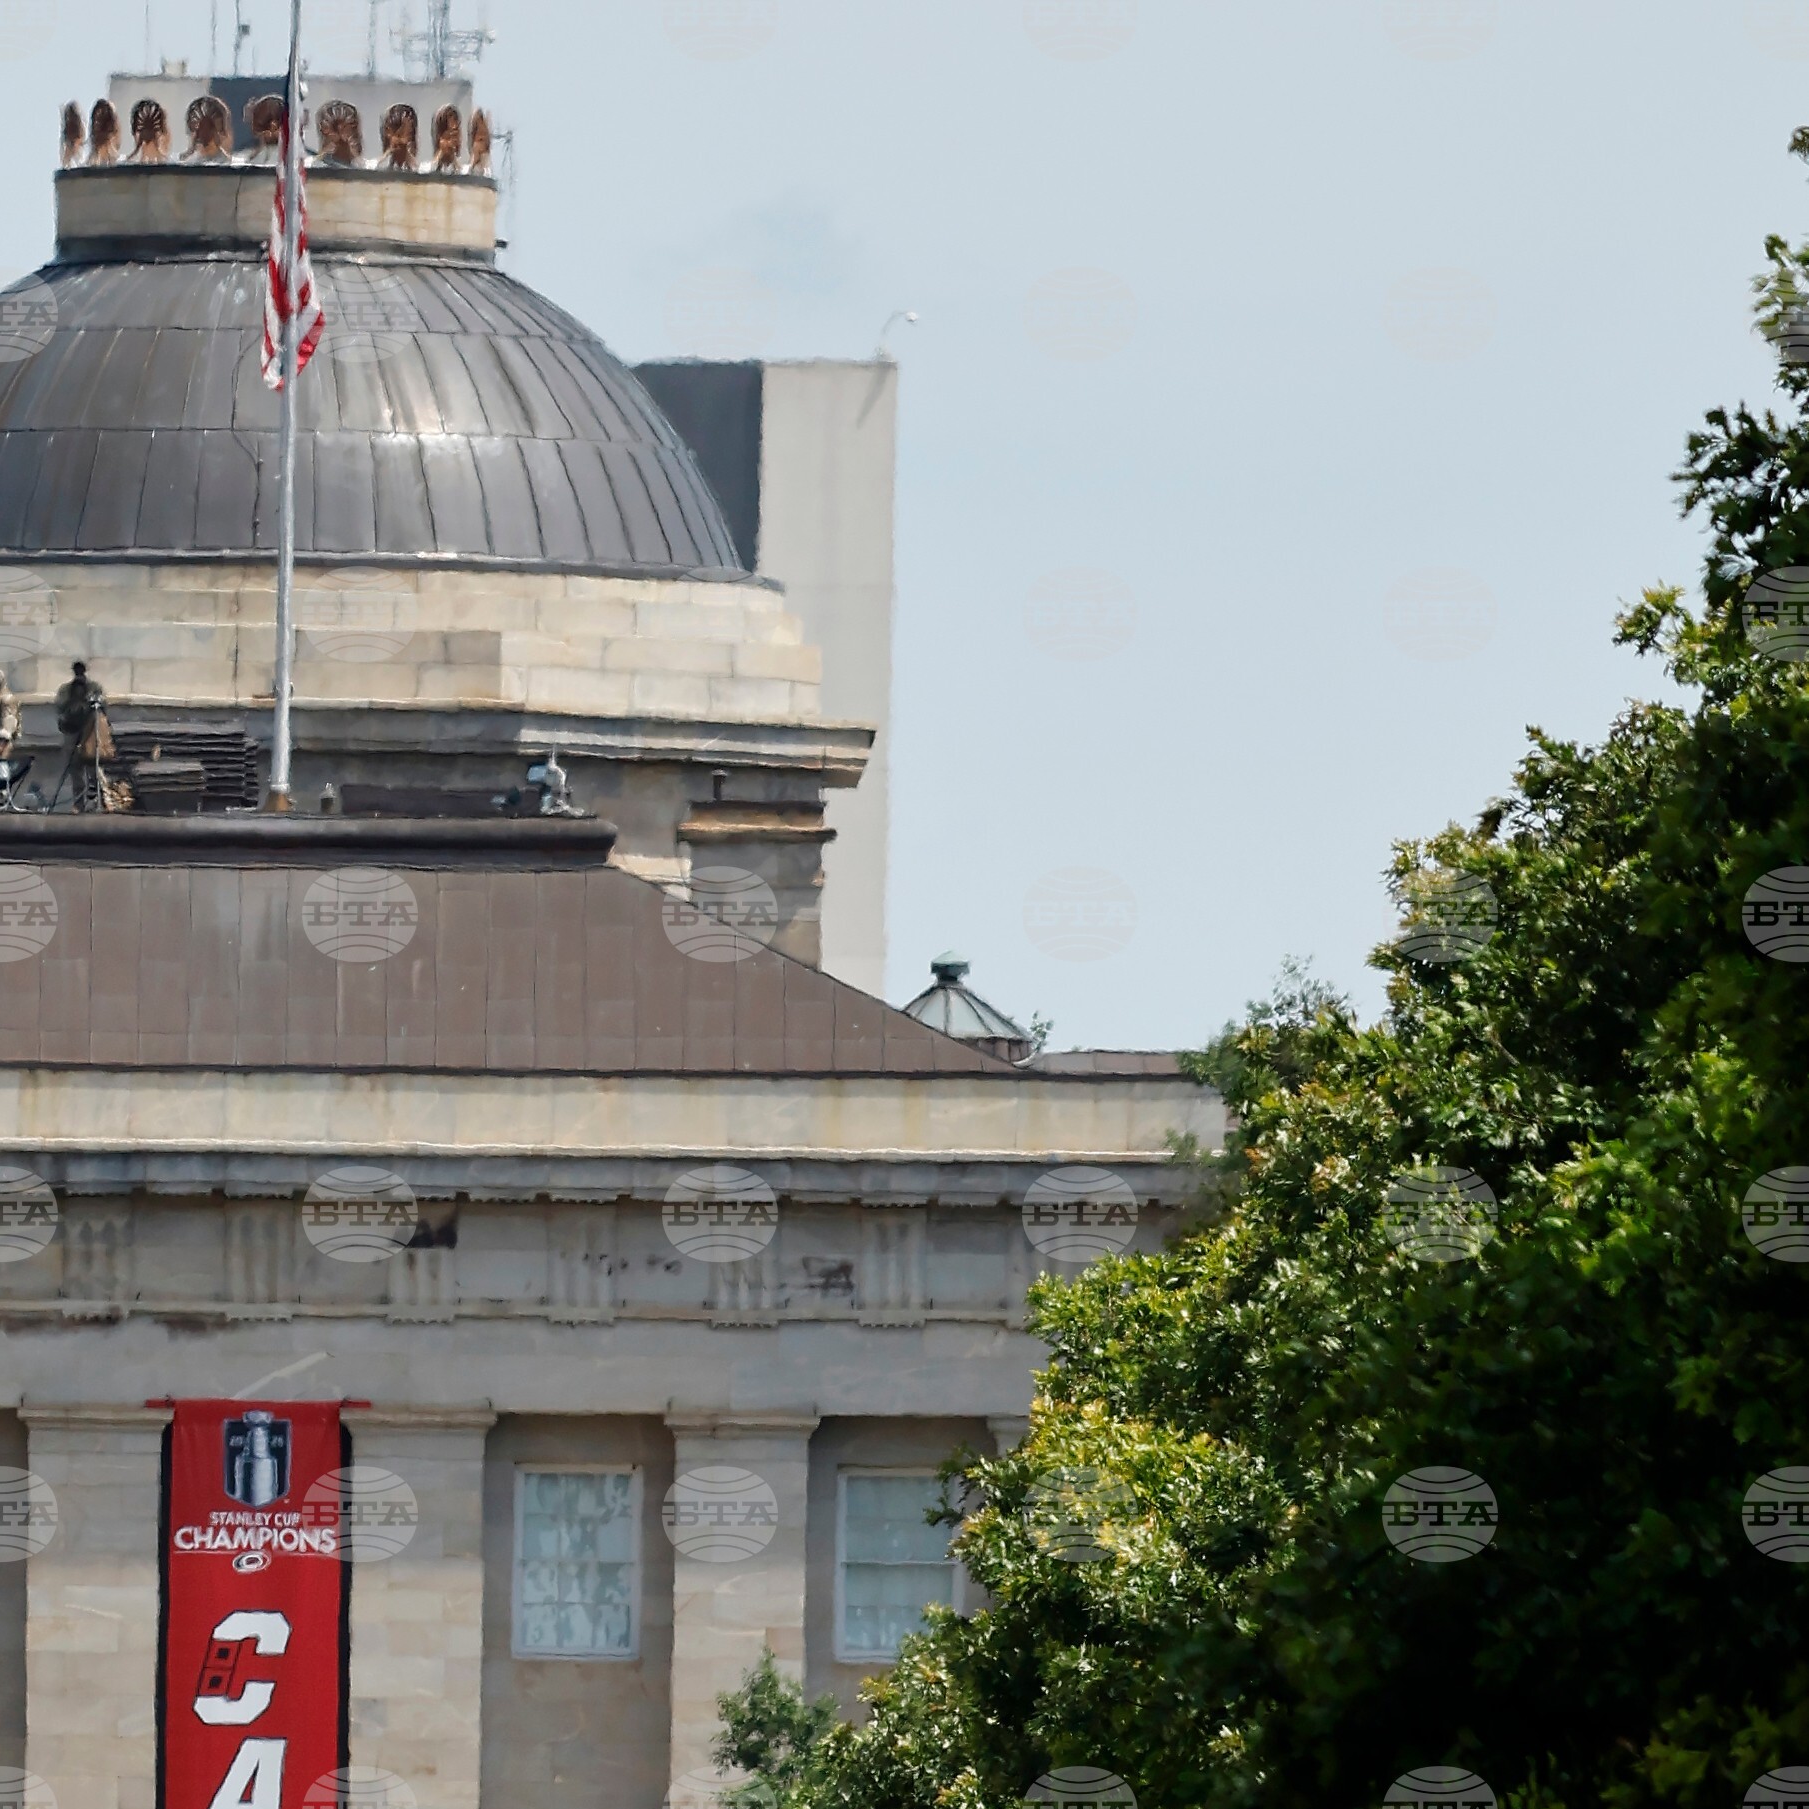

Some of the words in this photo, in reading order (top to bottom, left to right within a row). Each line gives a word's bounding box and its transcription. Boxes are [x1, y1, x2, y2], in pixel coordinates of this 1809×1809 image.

[209, 1511, 271, 1526] STANLEY
[274, 1511, 301, 1526] CUP
[174, 1526, 337, 1554] CHAMPIONS
